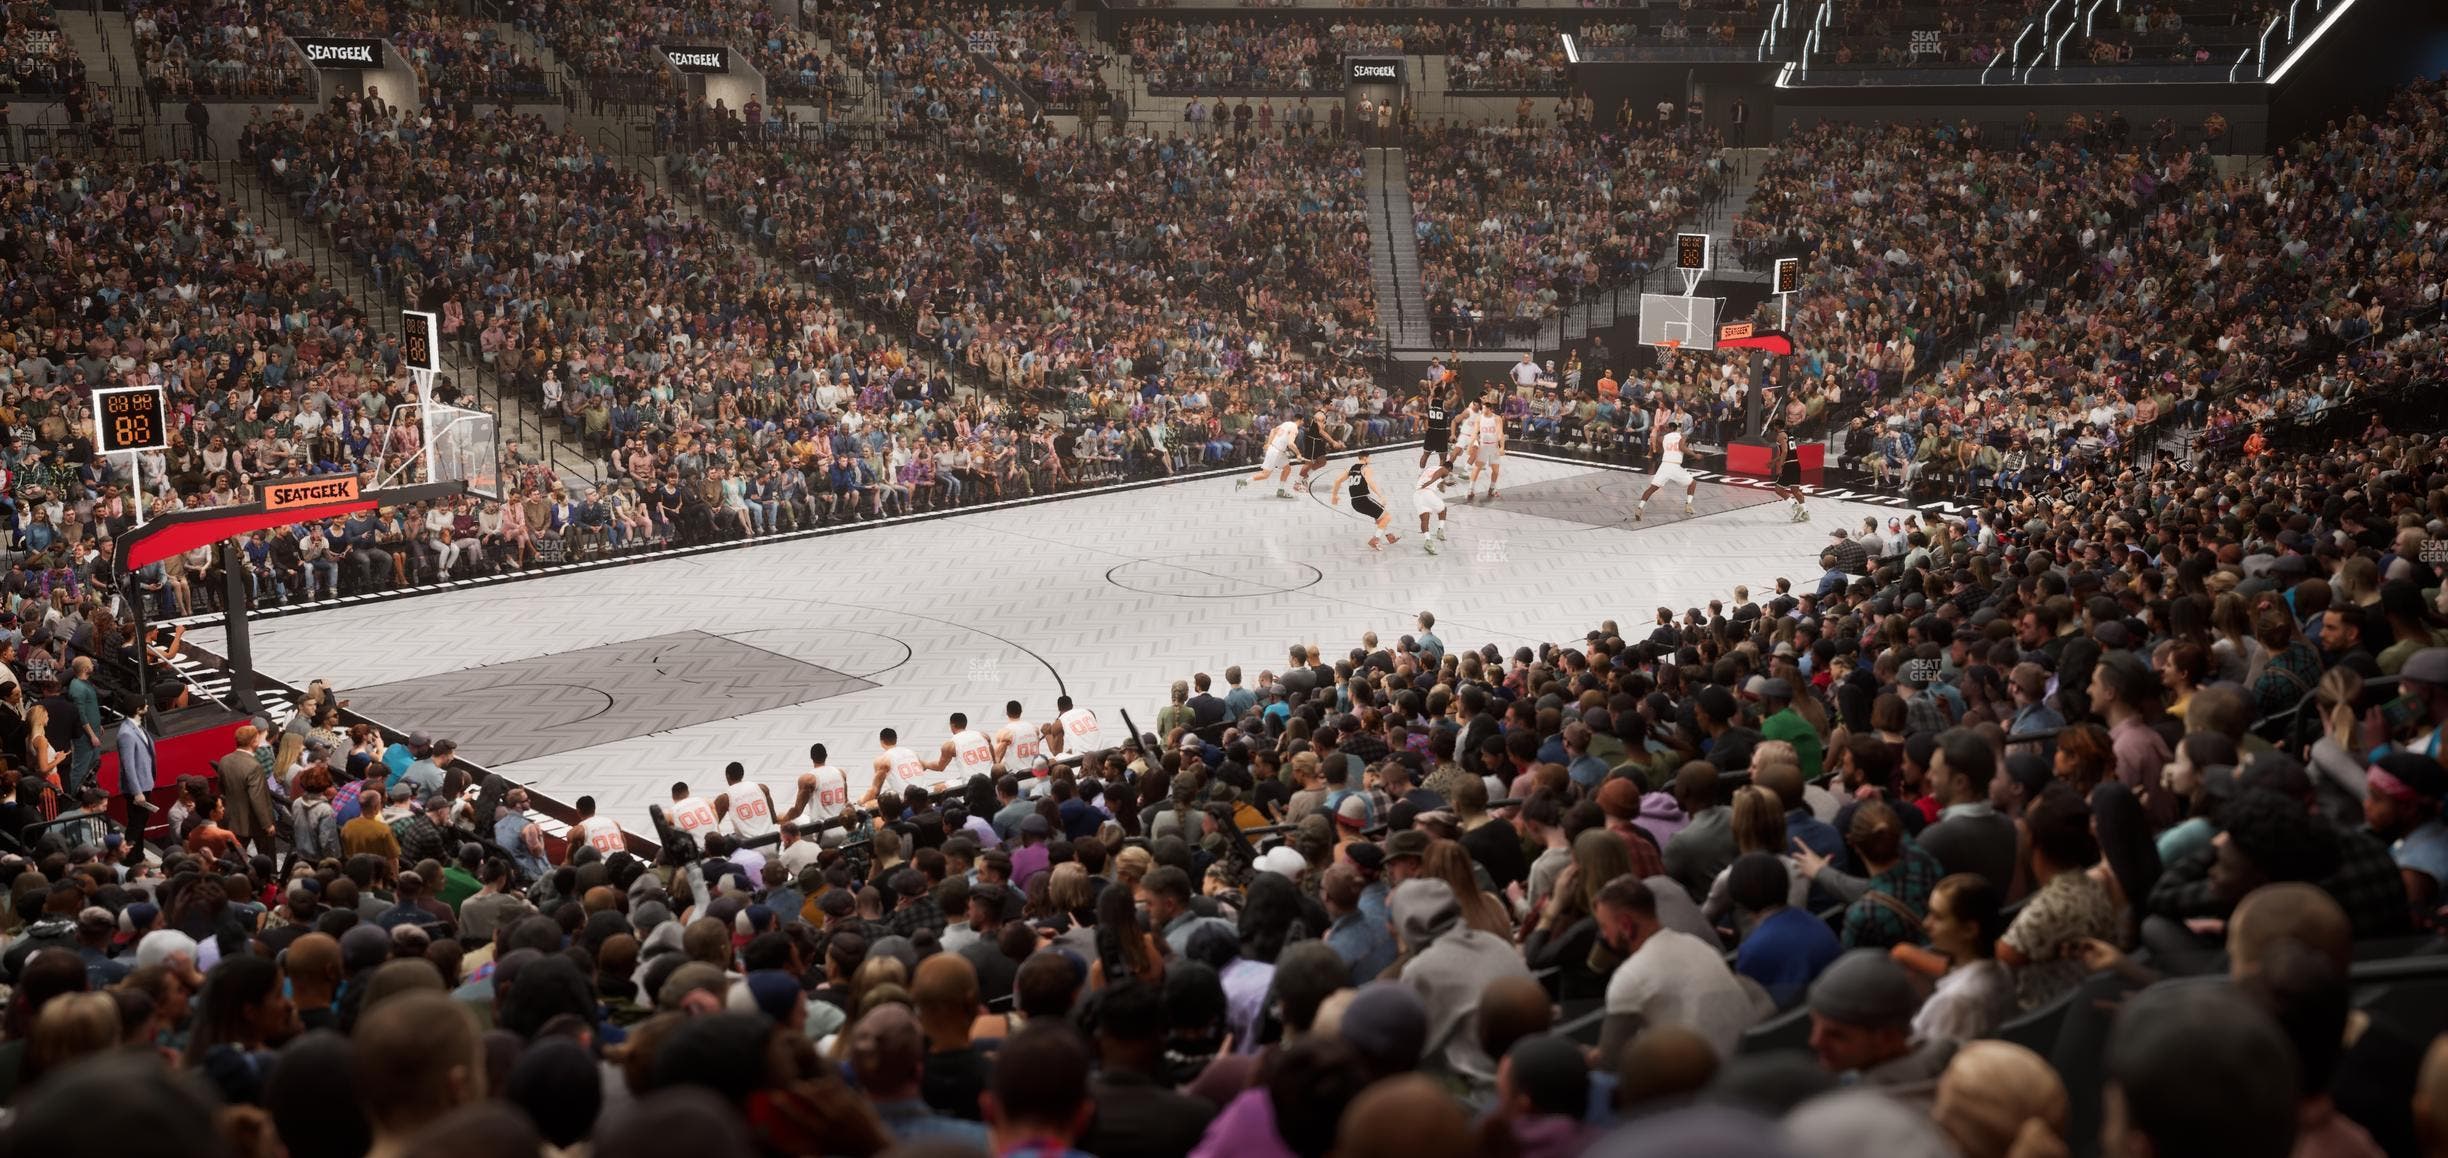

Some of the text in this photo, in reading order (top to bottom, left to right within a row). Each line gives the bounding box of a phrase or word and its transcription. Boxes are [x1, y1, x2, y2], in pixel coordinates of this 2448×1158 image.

[307, 44, 373, 63] SEATGEEK
[668, 51, 721, 68] SEATGEEK
[1353, 65, 1396, 78] SEATGEEK
[108, 393, 152, 413] 88 88
[1429, 409, 1444, 420] 00
[115, 414, 151, 446] 88
[273, 481, 351, 505] SEATGEEK
[1070, 715, 1100, 738] 00
[962, 745, 991, 766] 00
[1017, 741, 1040, 759] 00
[820, 787, 845, 806] 00
[678, 806, 713, 832] 00
[736, 799, 768, 821] 00
[591, 832, 624, 852] 00
